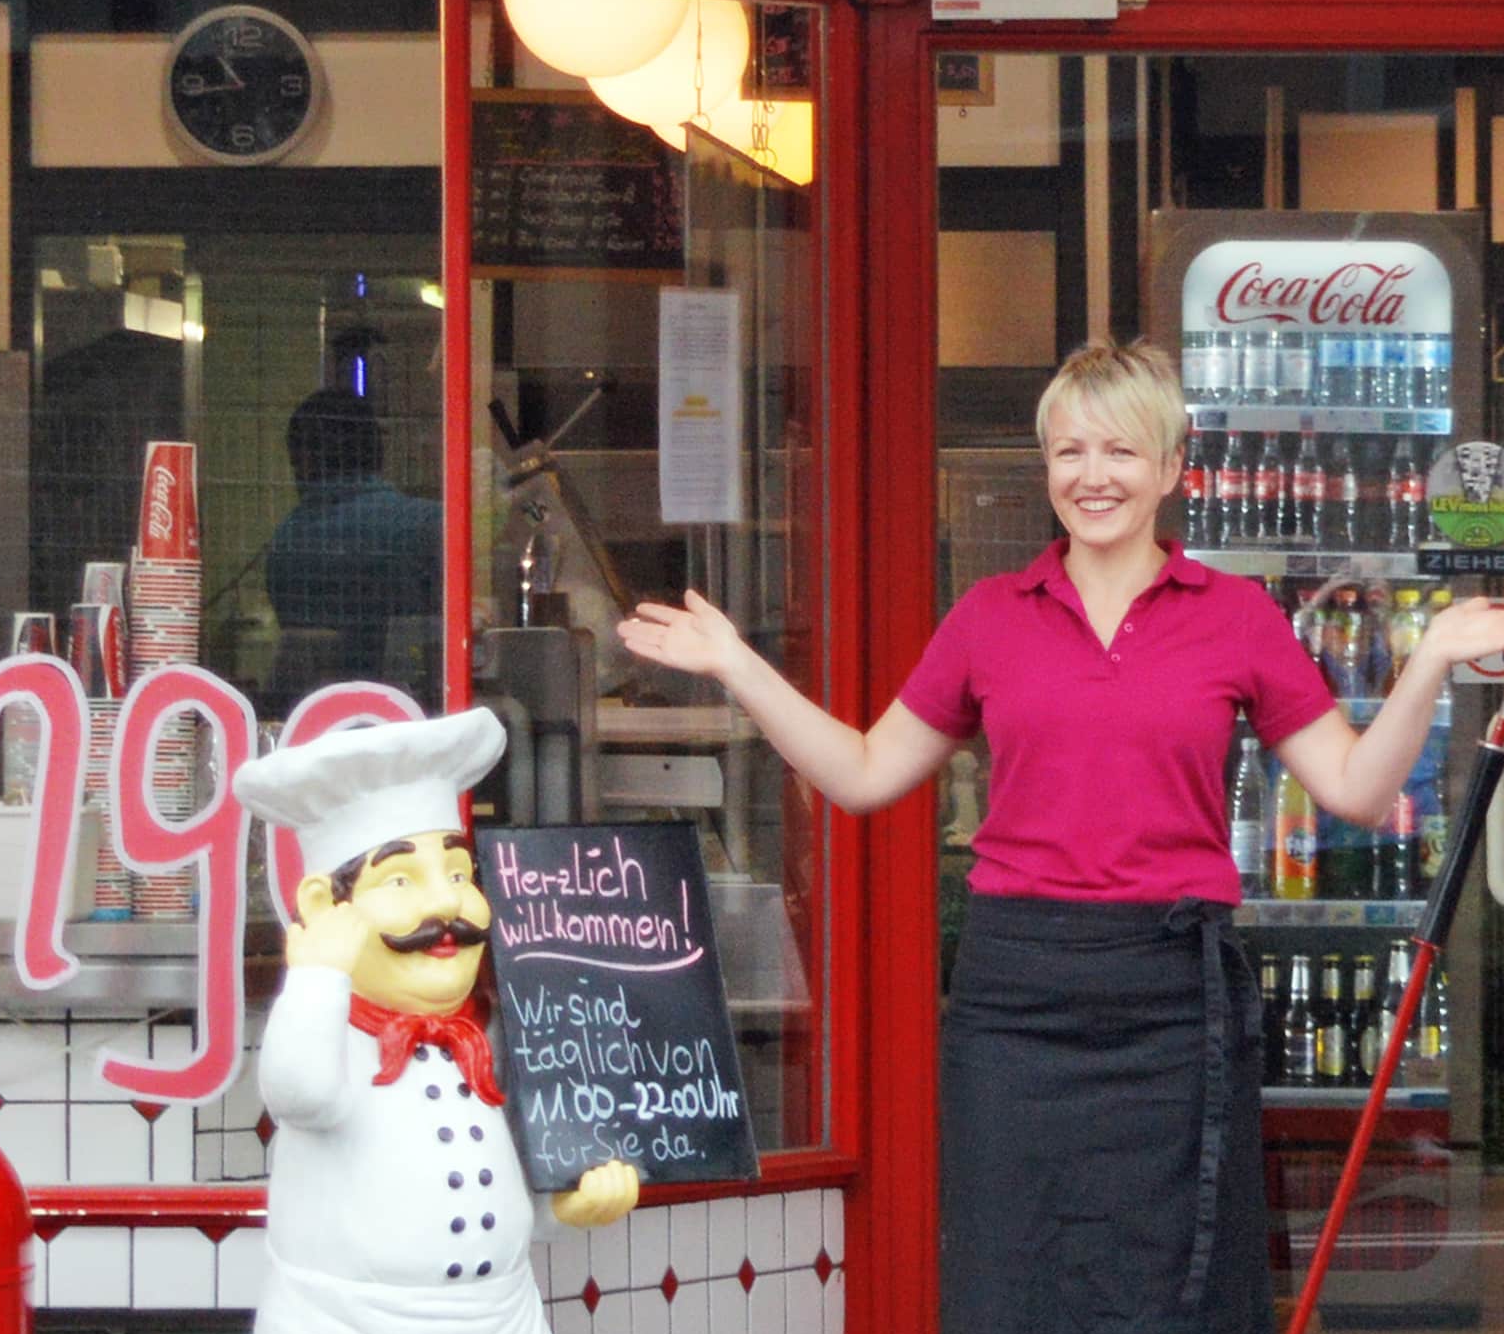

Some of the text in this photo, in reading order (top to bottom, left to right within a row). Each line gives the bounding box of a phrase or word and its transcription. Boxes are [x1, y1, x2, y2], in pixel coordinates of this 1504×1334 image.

[1215, 262, 1416, 327] Coca-Cola
[497, 835, 648, 902] Herzlich
[507, 981, 565, 1028] Wir
[514, 1026, 720, 1091] täglich von
